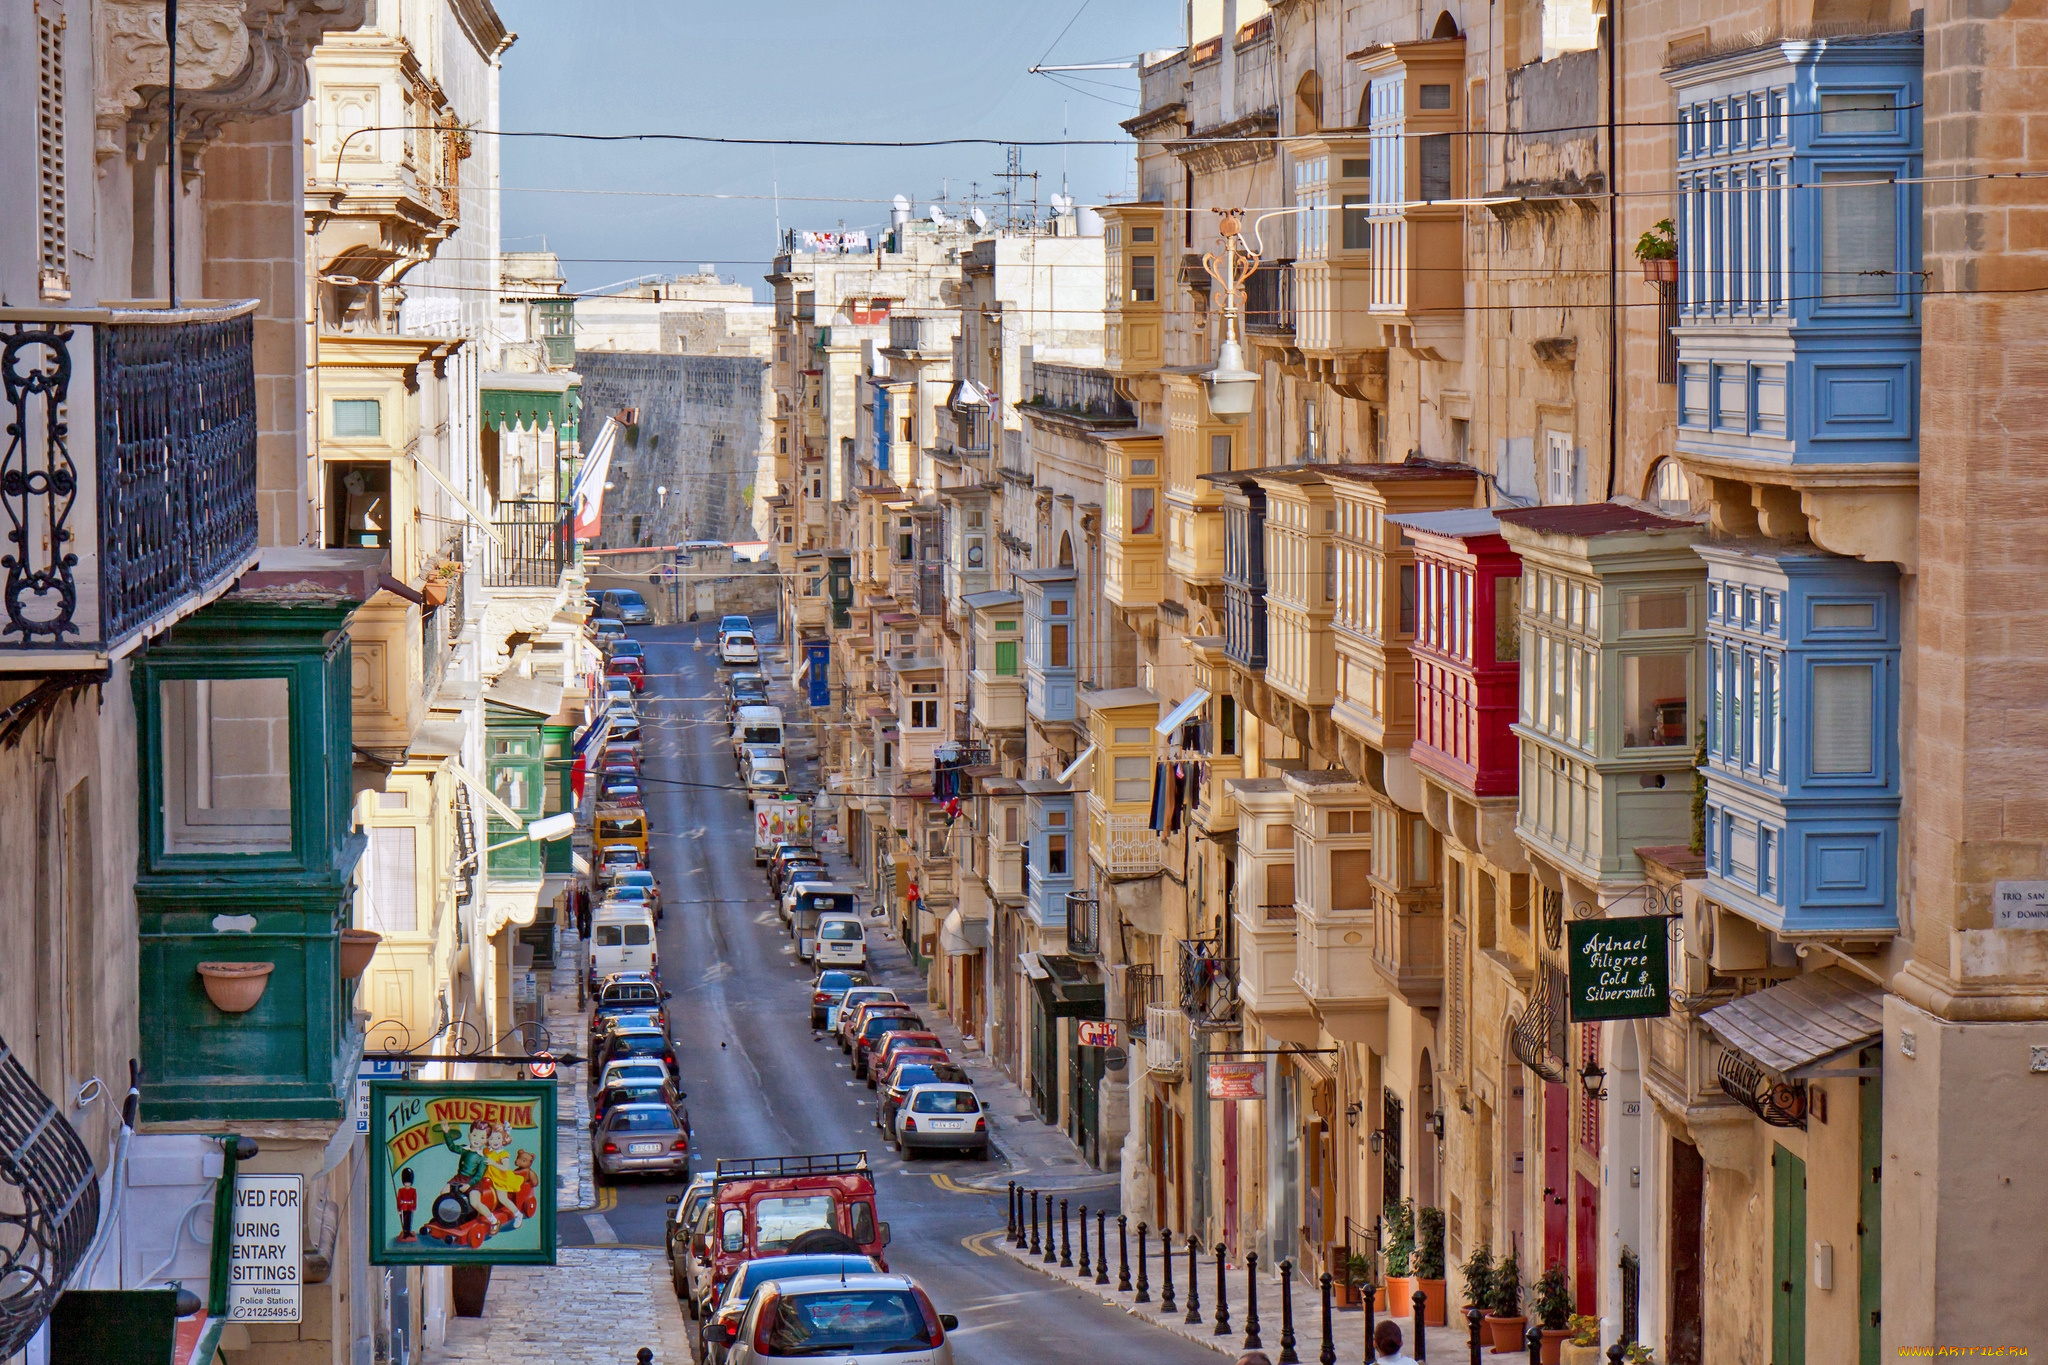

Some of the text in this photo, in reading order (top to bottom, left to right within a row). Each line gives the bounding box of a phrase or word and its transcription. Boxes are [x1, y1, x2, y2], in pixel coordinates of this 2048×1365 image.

[1583, 933, 1647, 954] Ardnael
[1589, 952, 1648, 971] Filigree
[1600, 970, 1649, 986] Gold &
[1586, 984, 1655, 1001] Silversmith
[388, 1098, 420, 1134] The
[434, 1101, 532, 1126] MUSEUM
[1627, 1104, 1639, 1113] 80
[392, 1126, 432, 1160] TOY
[269, 1189, 298, 1207] FOR
[233, 1265, 296, 1280] SITTINGS
[252, 1287, 281, 1295] Valletta
[240, 1297, 294, 1305] Police Station
[247, 1307, 297, 1317] 21225495-6
